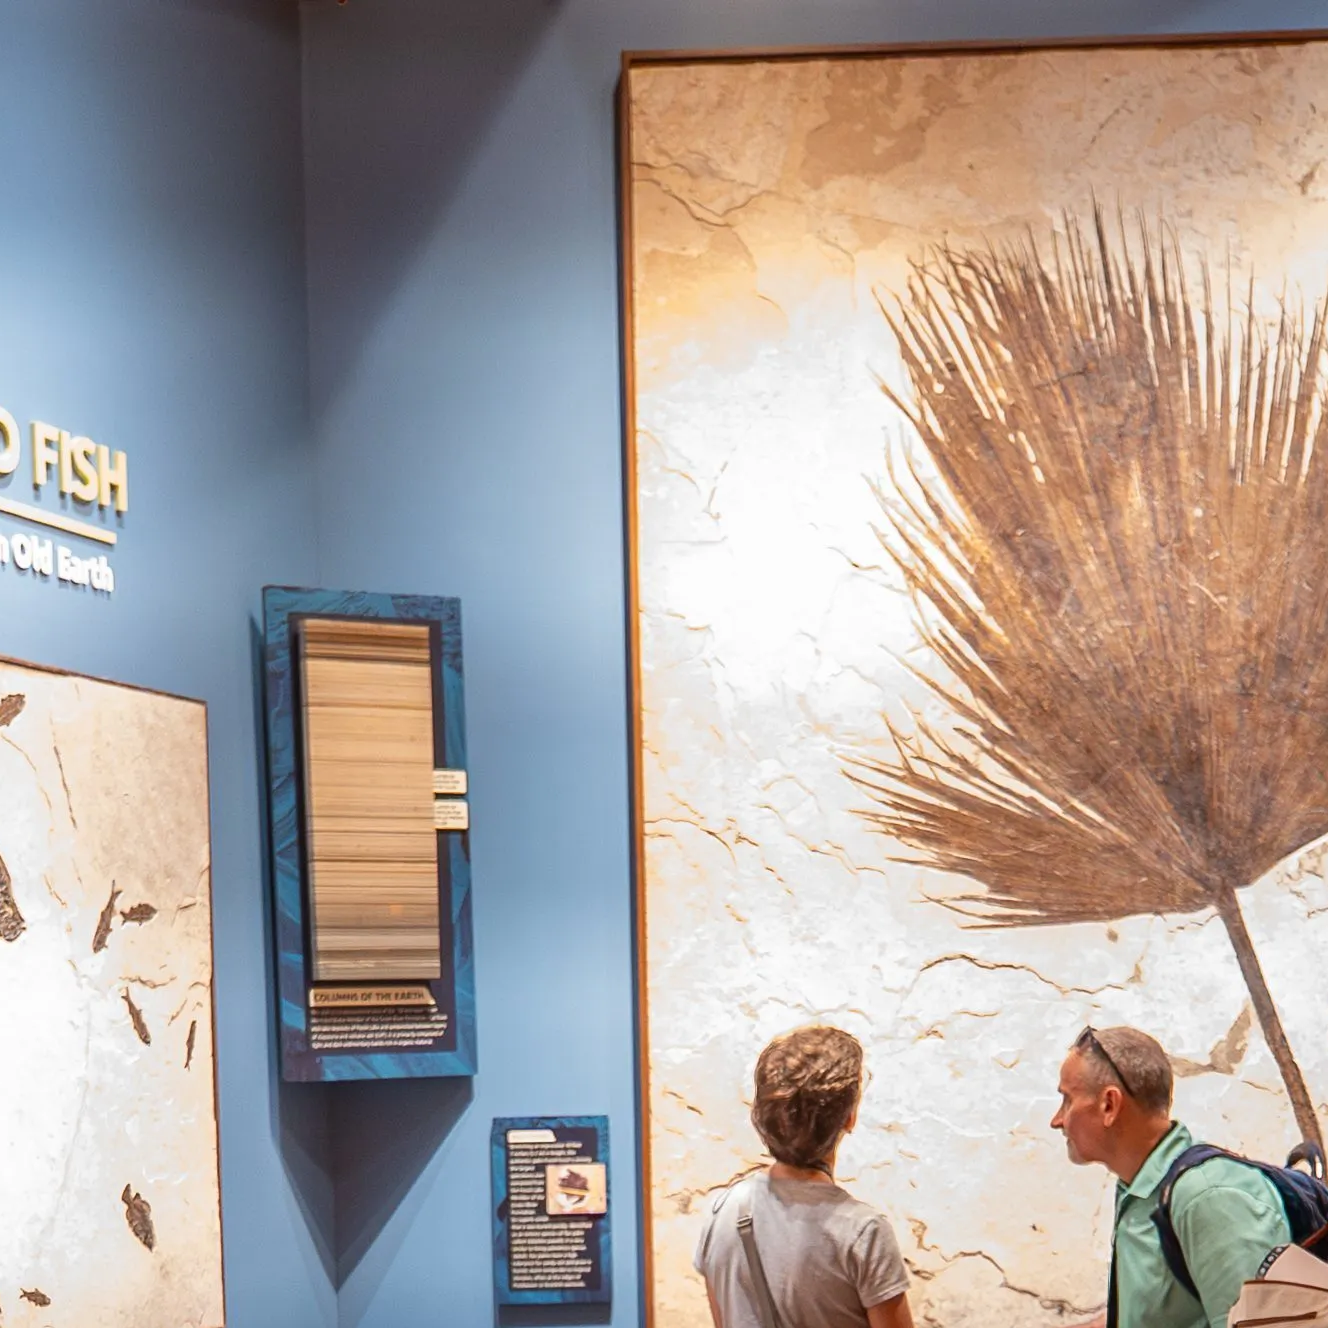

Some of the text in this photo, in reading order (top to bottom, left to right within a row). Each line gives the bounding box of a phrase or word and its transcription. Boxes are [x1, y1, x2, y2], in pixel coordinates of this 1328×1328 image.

[32, 421, 127, 512] FISH
[13, 533, 53, 575] Old
[57, 545, 114, 592] Earth
[314, 991, 424, 1002] COLUMNS OF THE EARTH
